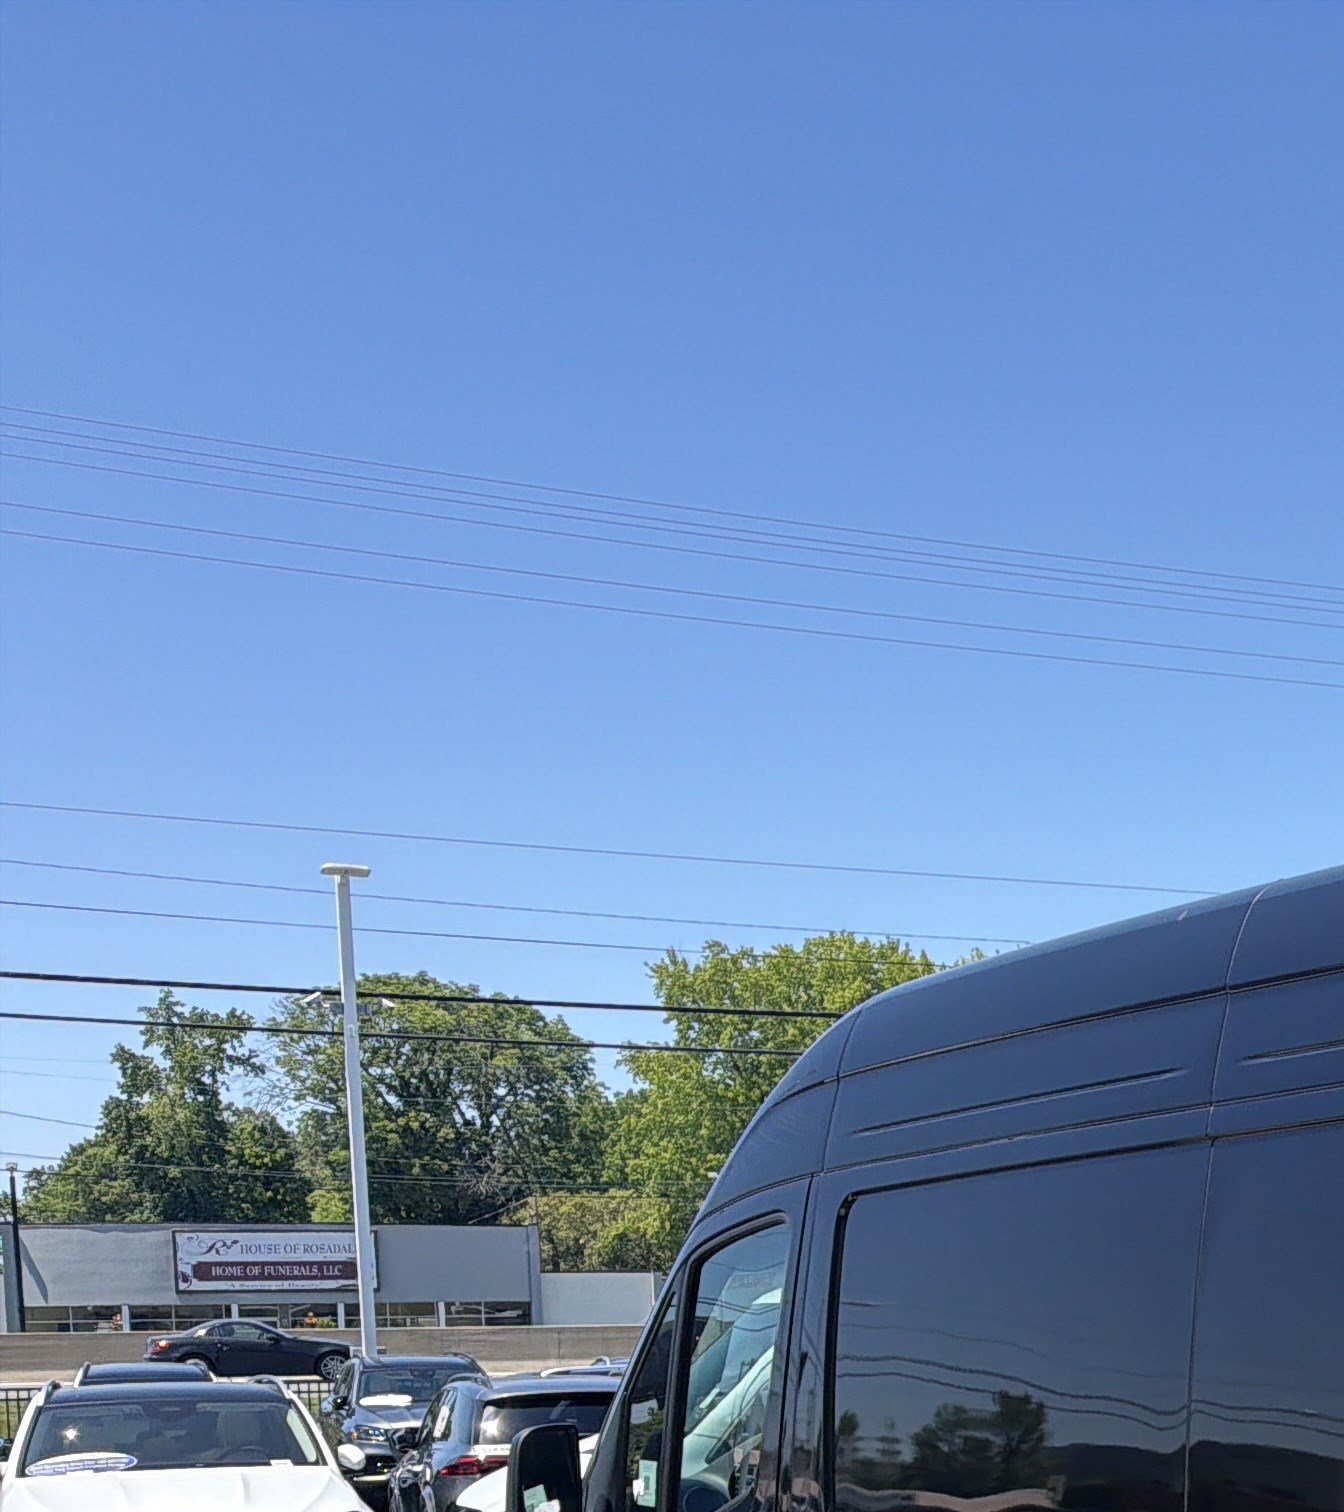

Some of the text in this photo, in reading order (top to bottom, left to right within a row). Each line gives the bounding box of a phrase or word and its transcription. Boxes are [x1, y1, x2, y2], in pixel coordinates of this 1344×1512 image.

[240, 1243, 357, 1255] HOUSE OF ROSADAL
[211, 1264, 343, 1278] HOME OF FUNERALS, LLC
